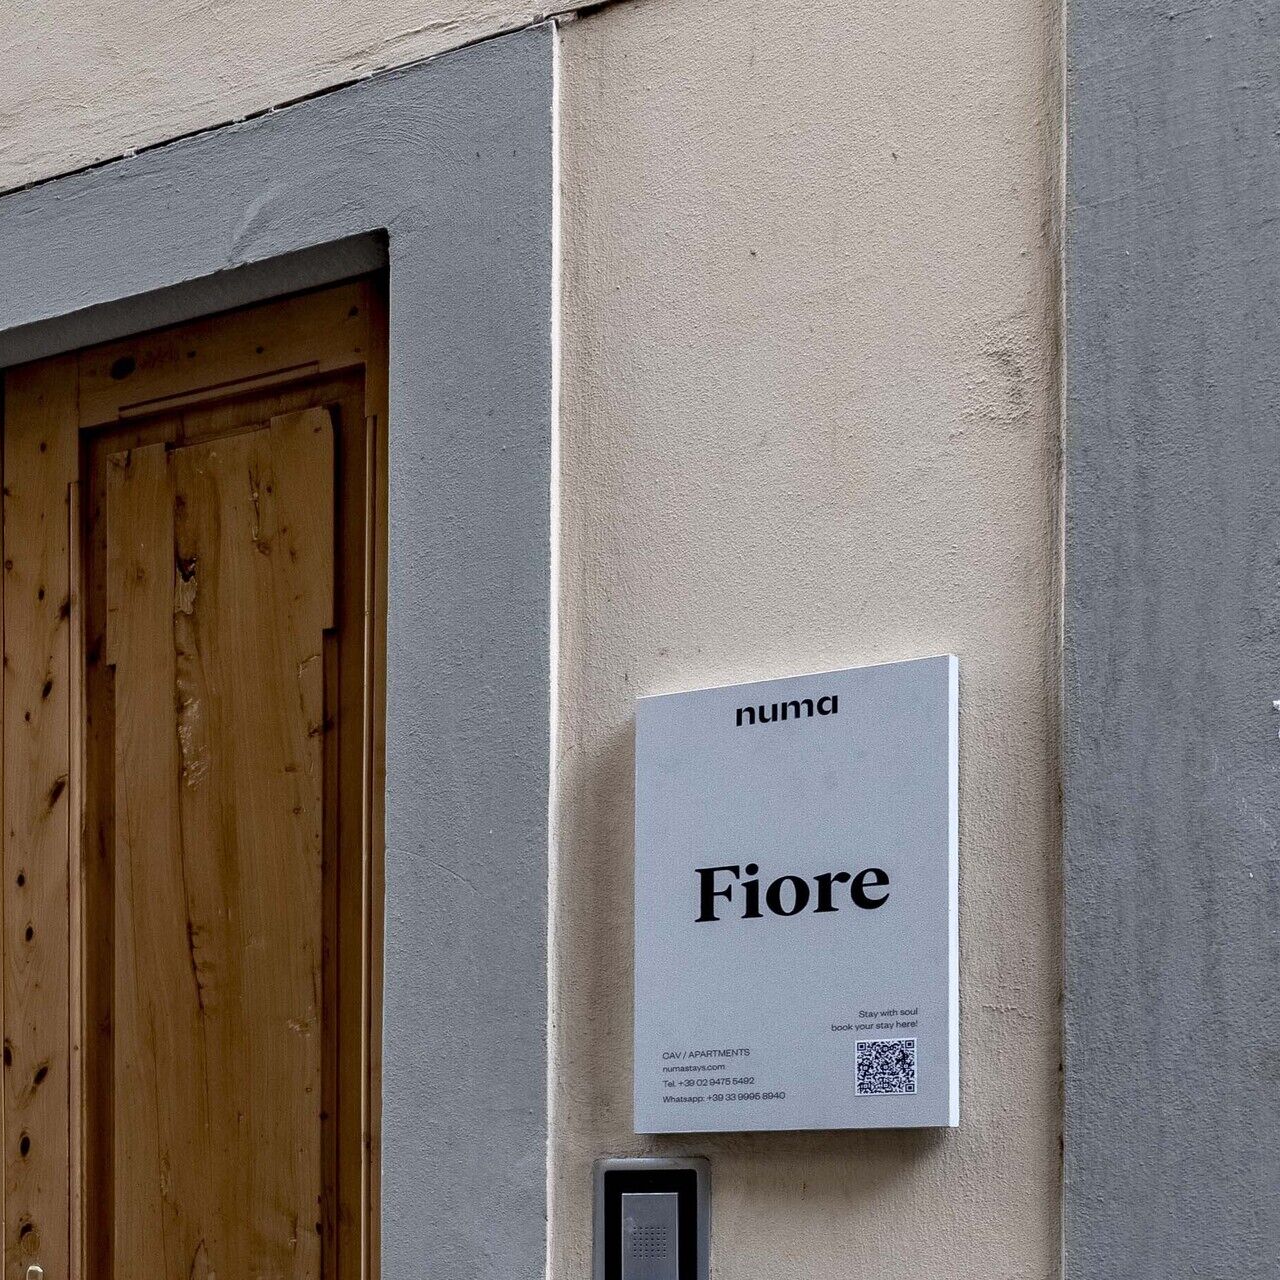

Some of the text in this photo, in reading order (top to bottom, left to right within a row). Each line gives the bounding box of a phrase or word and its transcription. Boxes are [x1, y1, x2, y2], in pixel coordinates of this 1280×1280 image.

[735, 694, 839, 727] numa
[694, 862, 890, 923] Fiore
[858, 1007, 918, 1019] Stay with soul
[831, 1020, 918, 1032] book your stay here!
[662, 1051, 682, 1060] CAV
[688, 1048, 751, 1059] APARTMENTS
[662, 1064, 726, 1074] numastays.com
[678, 1079, 695, 1087] +39
[696, 1078, 708, 1087] 02
[709, 1077, 731, 1086] 9475
[732, 1077, 755, 1085] 5492
[707, 1093, 724, 1102] +39
[725, 1093, 736, 1101] 33
[762, 1091, 786, 1100] 8940
